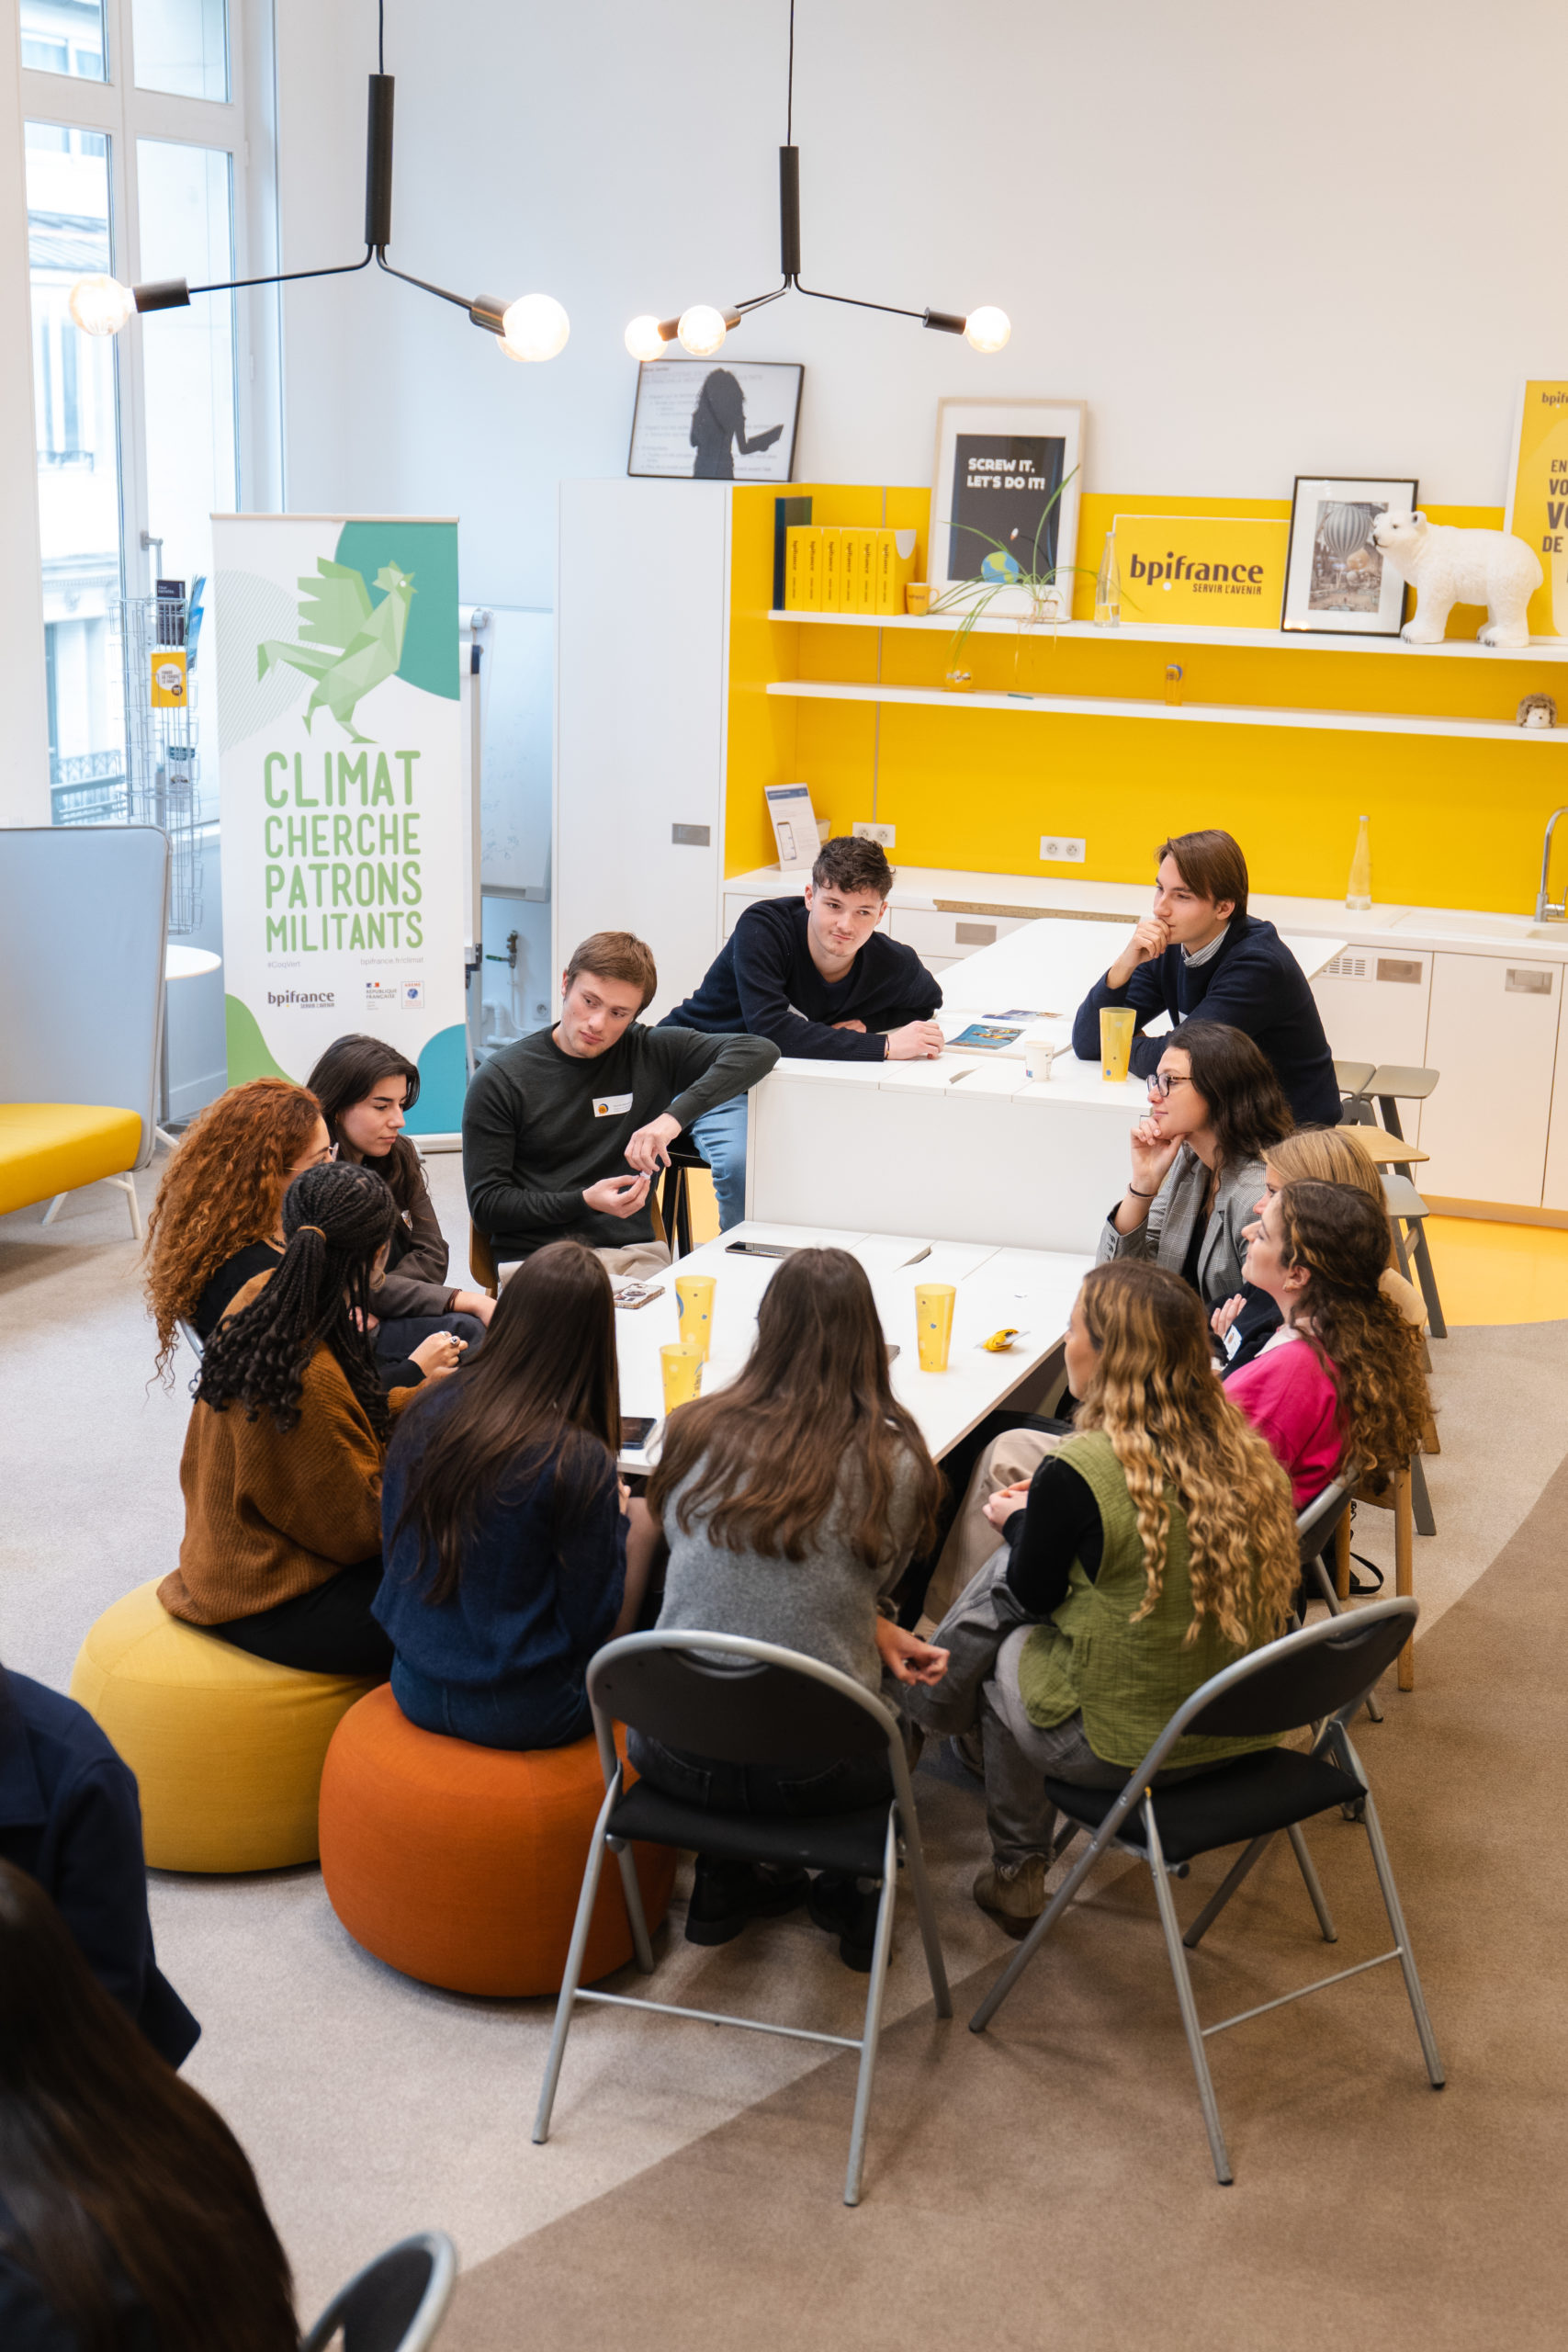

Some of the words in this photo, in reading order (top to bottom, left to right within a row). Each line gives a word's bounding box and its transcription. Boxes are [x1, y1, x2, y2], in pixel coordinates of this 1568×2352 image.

[968, 458, 1017, 471] SCREW
[966, 475, 1002, 489] LET'S
[1004, 476, 1025, 489] DO
[1027, 477, 1045, 491] IT!
[1547, 501, 1568, 529] V
[1541, 536, 1563, 552] DE
[1130, 551, 1264, 586] bpifrance
[1192, 582, 1223, 594] SERVIR
[1224, 584, 1262, 595] L'AVENIR
[264, 750, 422, 808] CLIMAT
[265, 812, 422, 859] CHERCHE
[265, 861, 423, 909] PATRONS
[265, 910, 423, 953] MILITANTS
[267, 989, 335, 1008] bpifrance
